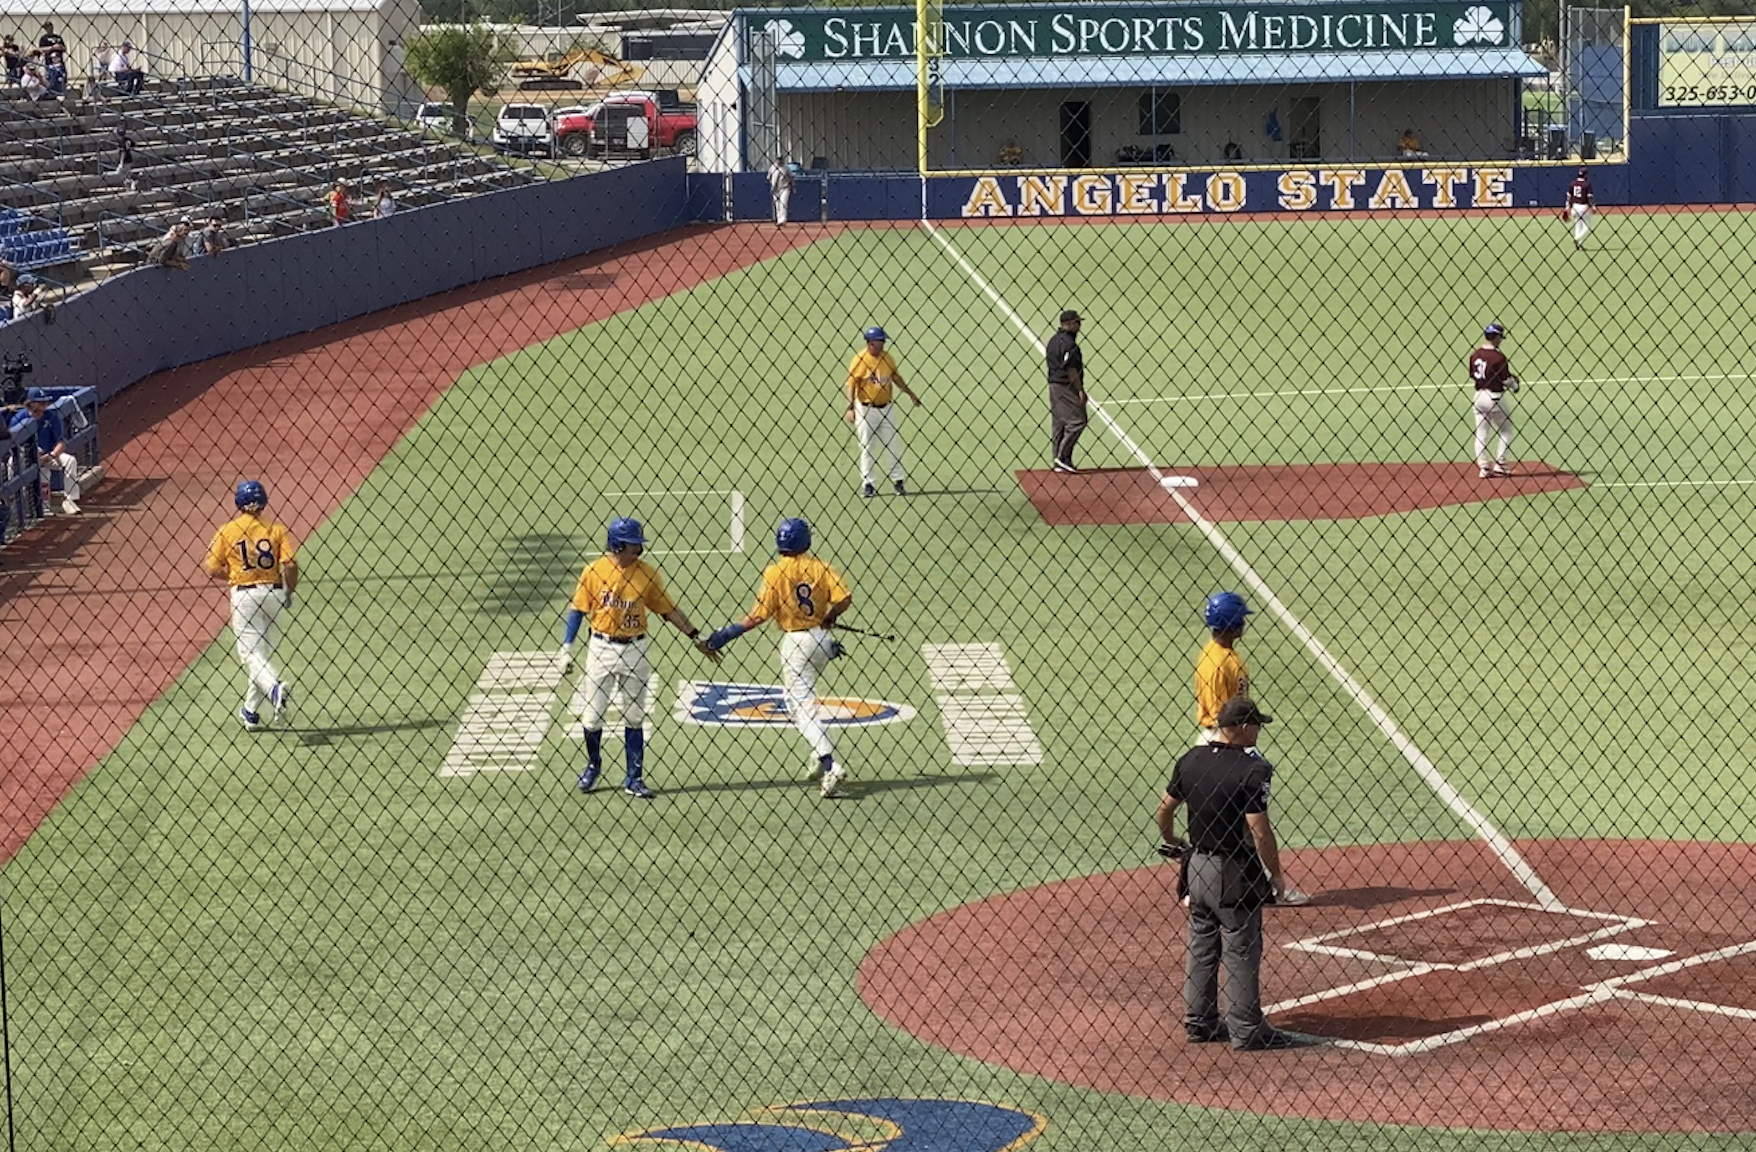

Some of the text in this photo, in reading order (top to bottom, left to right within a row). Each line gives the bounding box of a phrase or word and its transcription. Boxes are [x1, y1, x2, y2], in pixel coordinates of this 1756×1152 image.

[824, 10, 1438, 58] SHANNON SPORTS MEDICINE
[961, 168, 1513, 217] ANGELO STATE
[1573, 185, 1582, 197] 12
[1474, 358, 1487, 379] 31
[236, 538, 275, 571] 18
[796, 582, 815, 617] 8
[624, 613, 640, 628] 35
